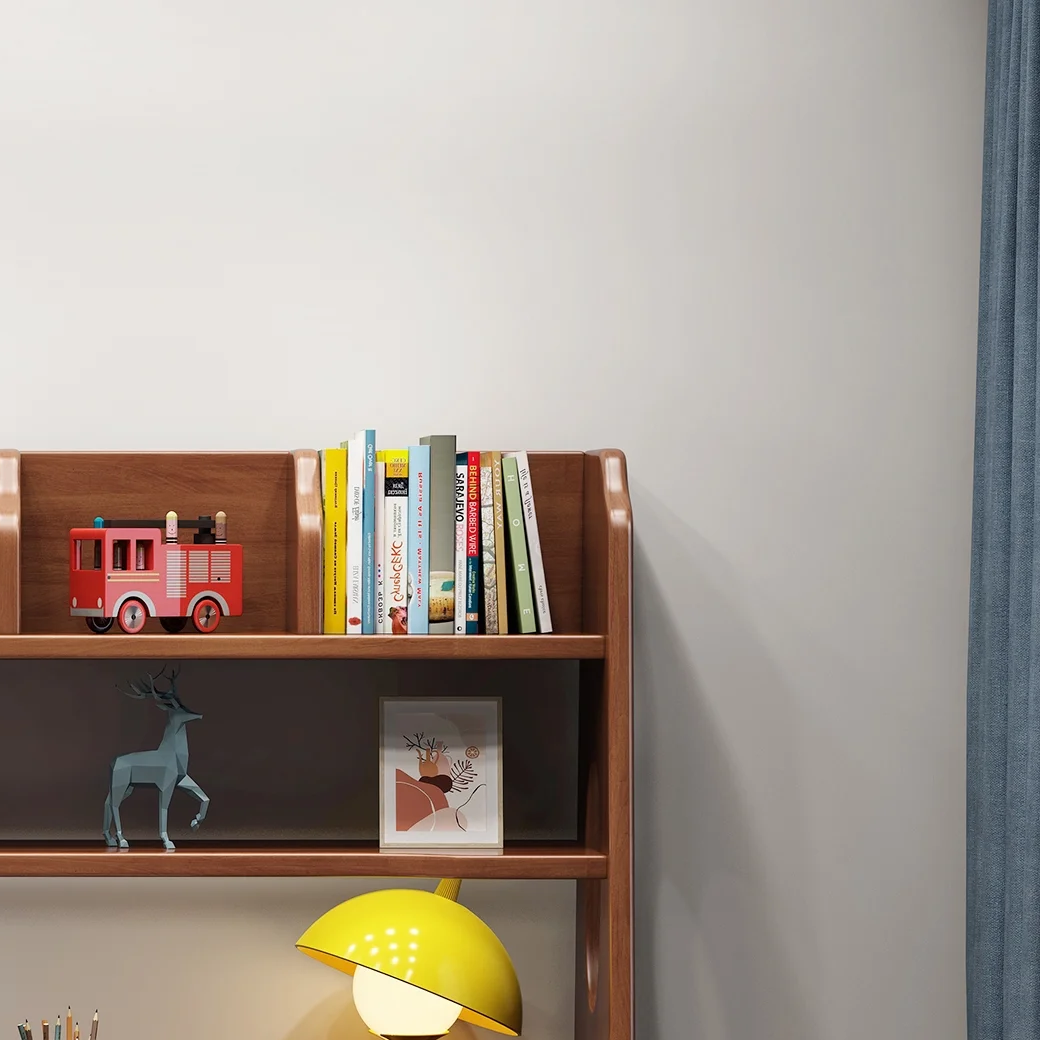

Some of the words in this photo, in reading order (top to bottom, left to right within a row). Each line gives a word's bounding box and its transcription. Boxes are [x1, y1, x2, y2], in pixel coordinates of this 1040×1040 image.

[455, 473, 464, 522] SARAJEVO
[469, 465, 477, 500] BEHIND
[468, 502, 477, 533] BARBED
[455, 524, 464, 552] ROSES
[468, 534, 476, 554] WIRE
